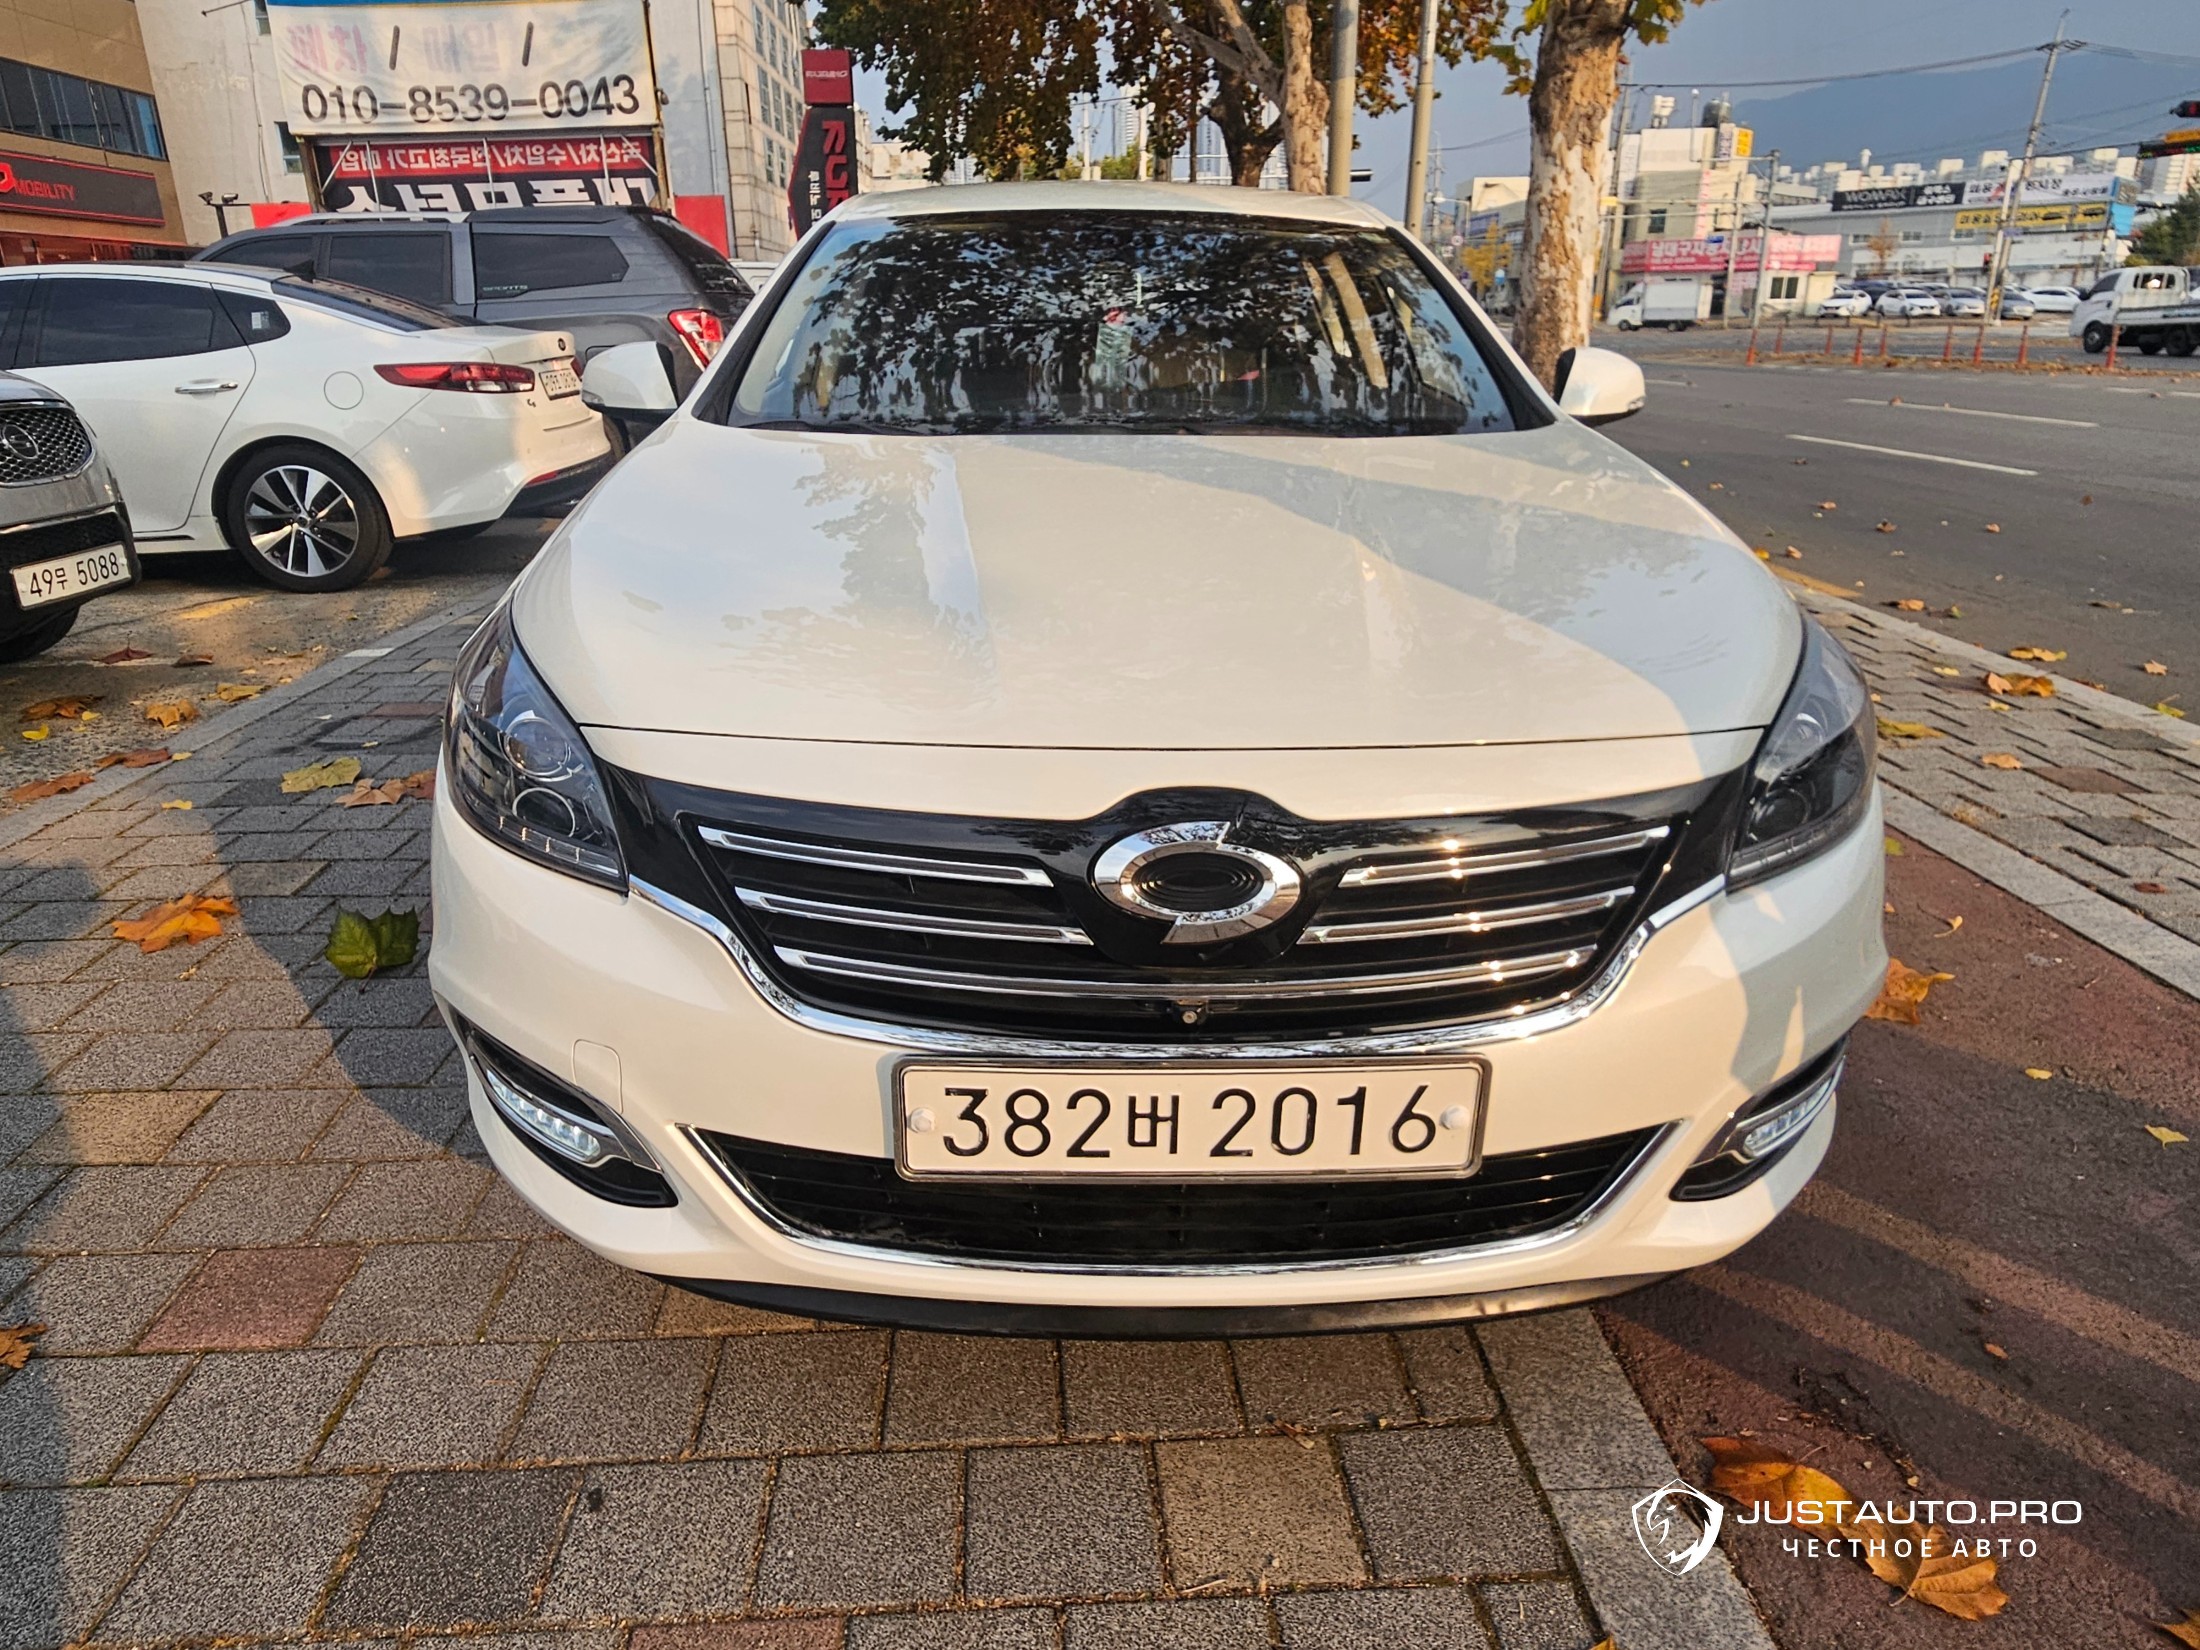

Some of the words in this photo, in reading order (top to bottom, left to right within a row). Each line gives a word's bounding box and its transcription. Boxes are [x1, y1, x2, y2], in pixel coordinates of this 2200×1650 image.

[301, 74, 640, 124] 010-8539-0043
[14, 179, 76, 201] MOBILITY
[29, 567, 68, 598] 49무
[76, 551, 120, 586] 5088
[942, 1086, 1180, 1158] 382버
[1208, 1084, 1438, 1158] 2016
